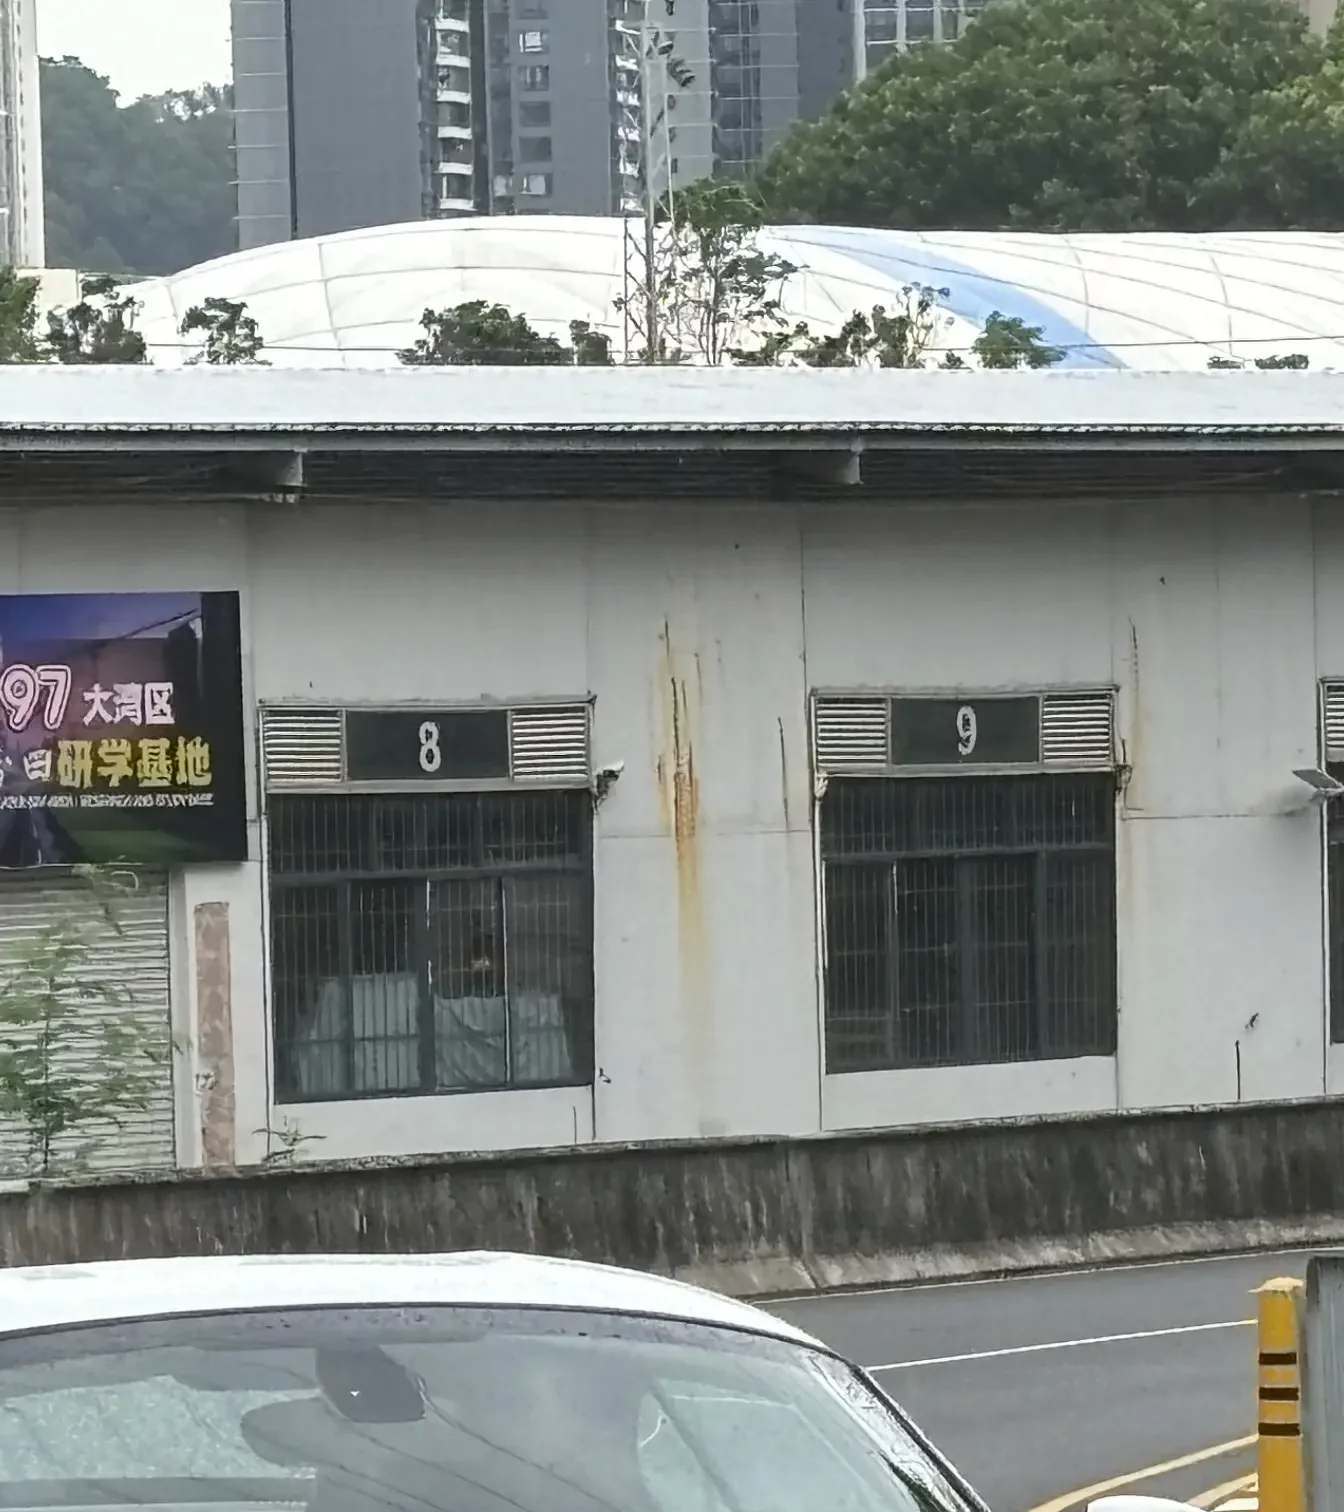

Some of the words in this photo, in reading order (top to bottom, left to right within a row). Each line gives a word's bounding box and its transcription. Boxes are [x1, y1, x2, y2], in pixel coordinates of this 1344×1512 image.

[83, 682, 175, 726] 大湾区
[419, 721, 442, 773] 8
[957, 705, 977, 756] 9
